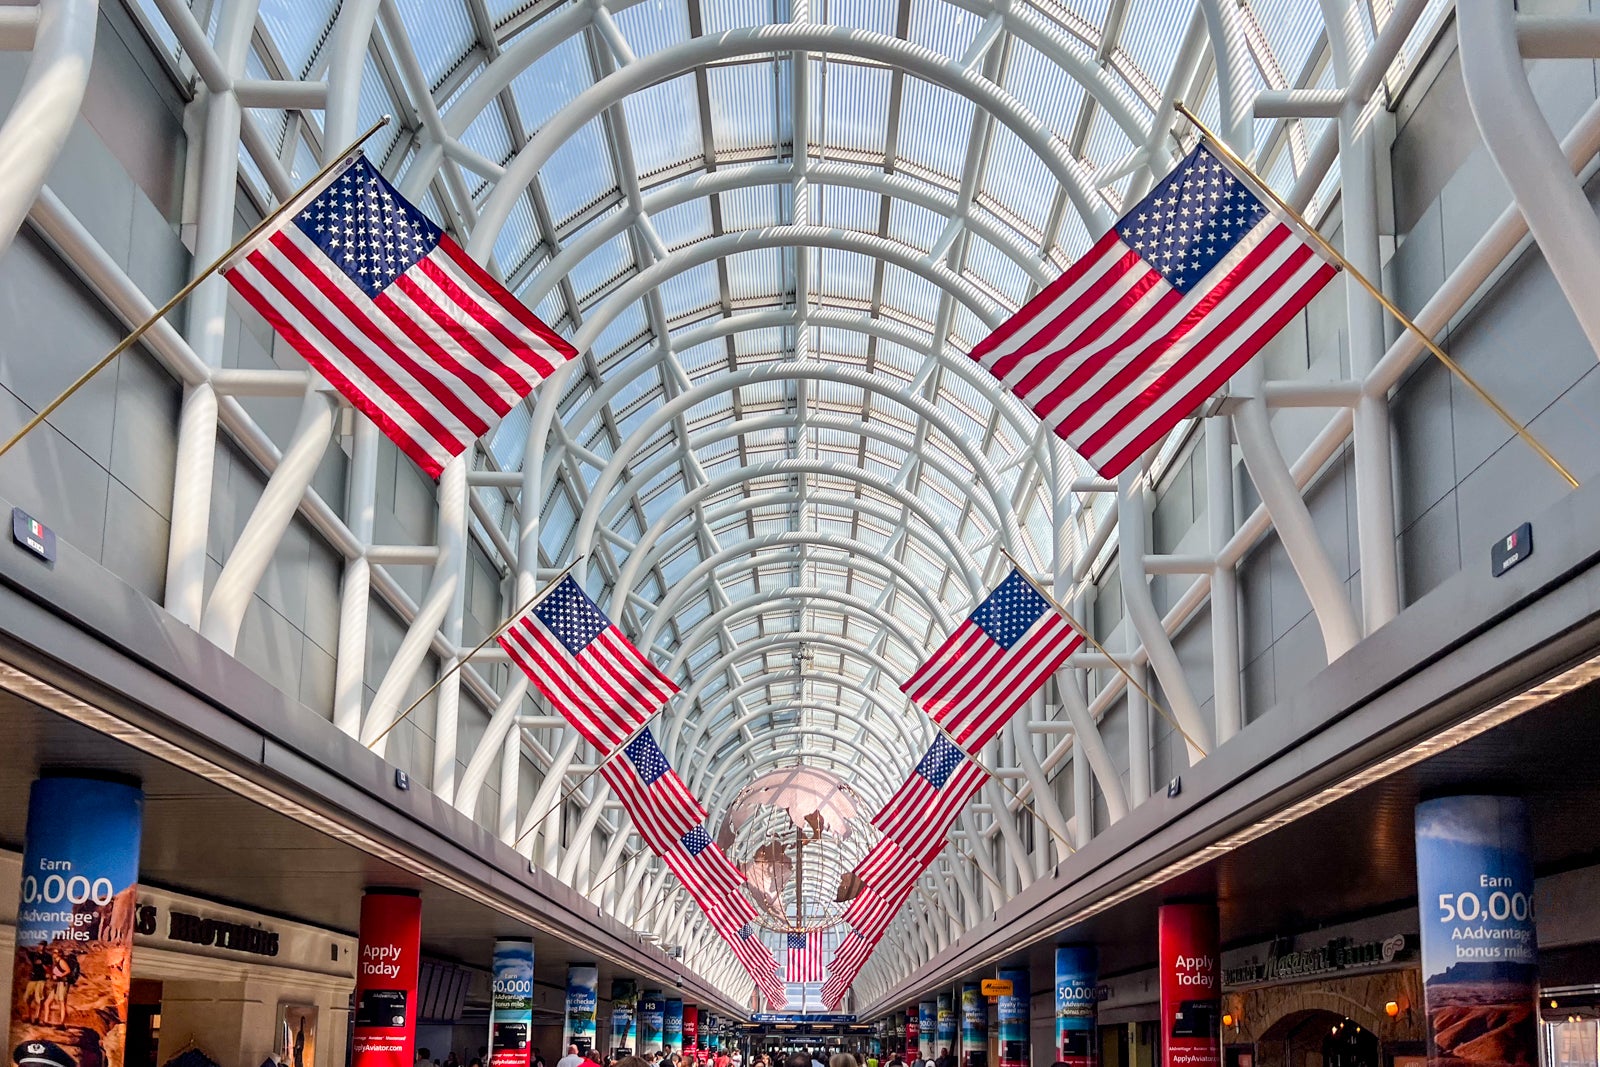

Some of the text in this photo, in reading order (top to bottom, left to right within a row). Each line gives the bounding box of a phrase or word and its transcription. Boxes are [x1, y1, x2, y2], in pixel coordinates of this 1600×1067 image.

[40, 858, 71, 870] Earn
[1479, 874, 1513, 888] Earn
[23, 874, 113, 906] 0,000
[20, 927, 90, 941] onus miles
[363, 943, 402, 961] Apply
[1456, 944, 1501, 958] bonus
[362, 961, 400, 979] Today
[1175, 954, 1214, 971] Apply
[1175, 971, 1214, 989] Today
[645, 1002, 656, 1010] H3
